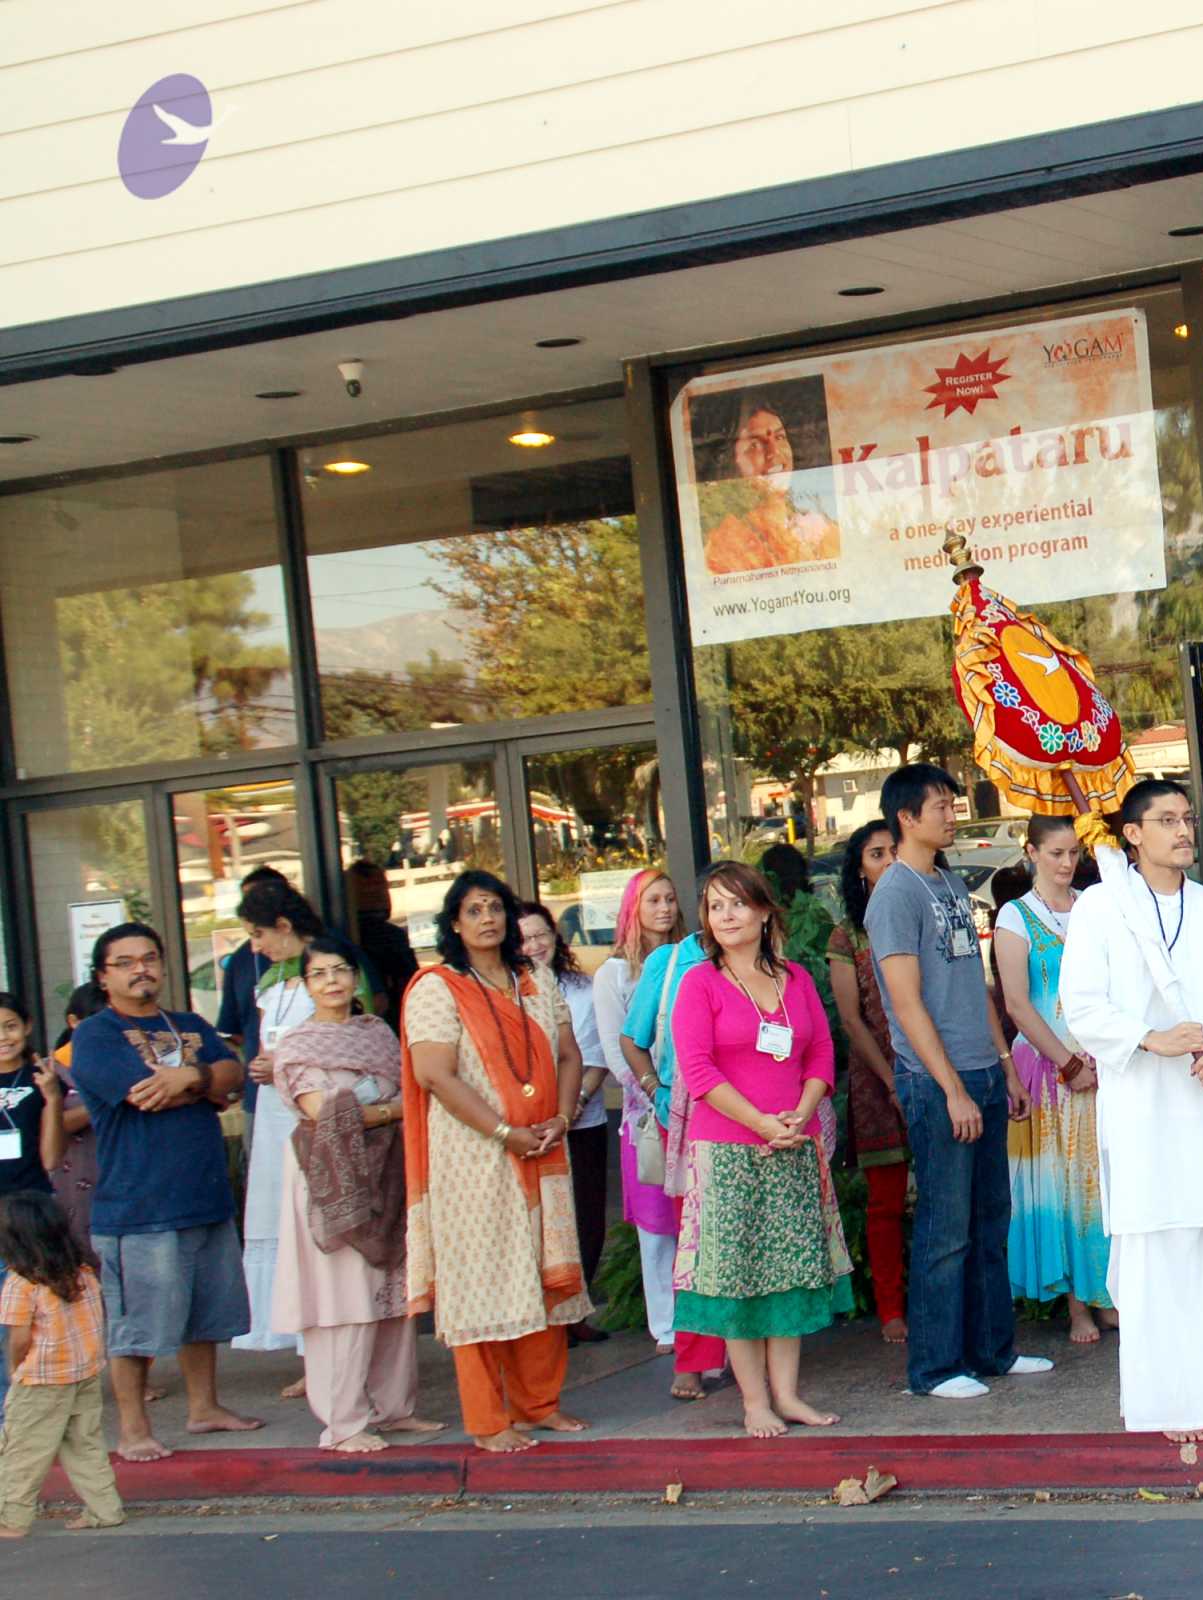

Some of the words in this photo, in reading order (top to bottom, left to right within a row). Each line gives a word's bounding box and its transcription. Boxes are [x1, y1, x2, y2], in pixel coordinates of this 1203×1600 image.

[1043, 335, 1122, 363] YOGAM
[945, 372, 993, 386] REGISTER
[838, 422, 1134, 497] Kalpataru
[889, 527, 900, 541] a
[981, 497, 1094, 531] experiential
[904, 544, 1003, 571] mediion
[1008, 535, 1089, 562] program
[713, 588, 851, 617] www.Yogam4You.org
